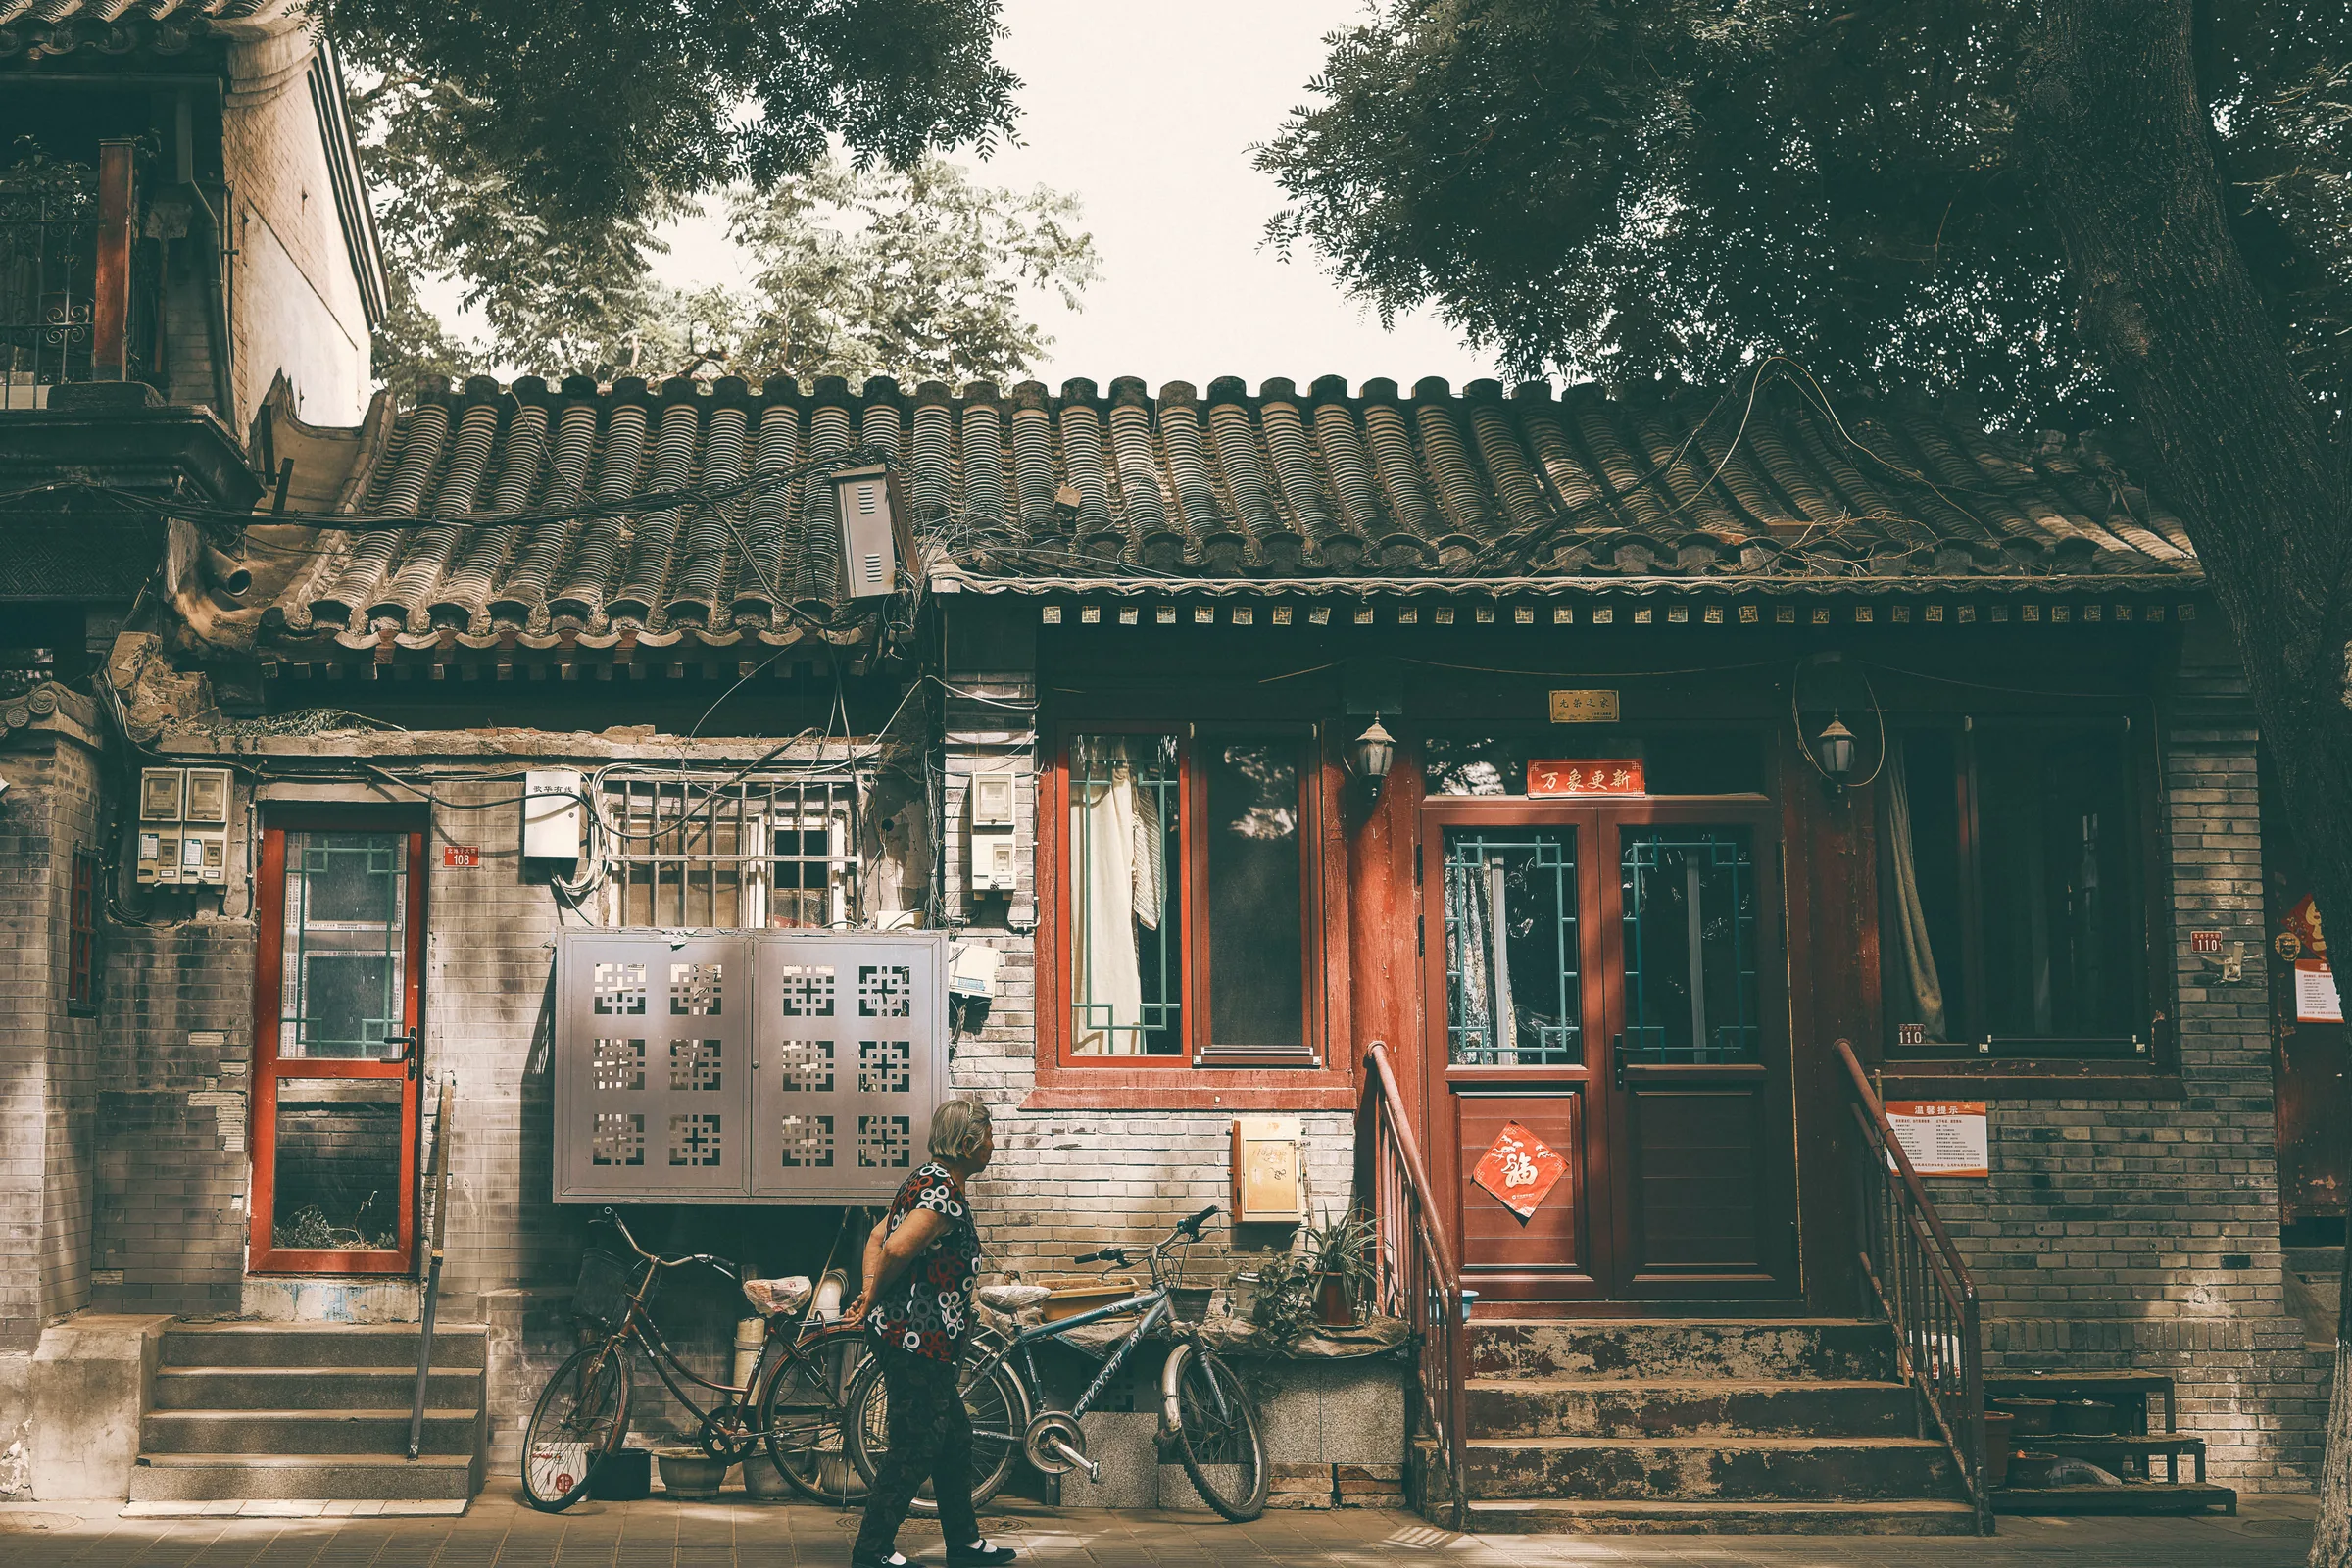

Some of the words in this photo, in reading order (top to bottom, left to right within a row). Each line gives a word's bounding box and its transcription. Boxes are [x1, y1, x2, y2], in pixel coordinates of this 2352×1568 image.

[1559, 696, 1610, 709] 光荣之家
[1540, 768, 1631, 792] 万象更新
[453, 854, 470, 865] 108
[2198, 939, 2218, 951] 110
[1898, 1031, 1922, 1044] 110
[1914, 1104, 1959, 1115] 温馨提示
[1500, 1152, 1539, 1189] 福
[1074, 1349, 1124, 1417] GIANT
